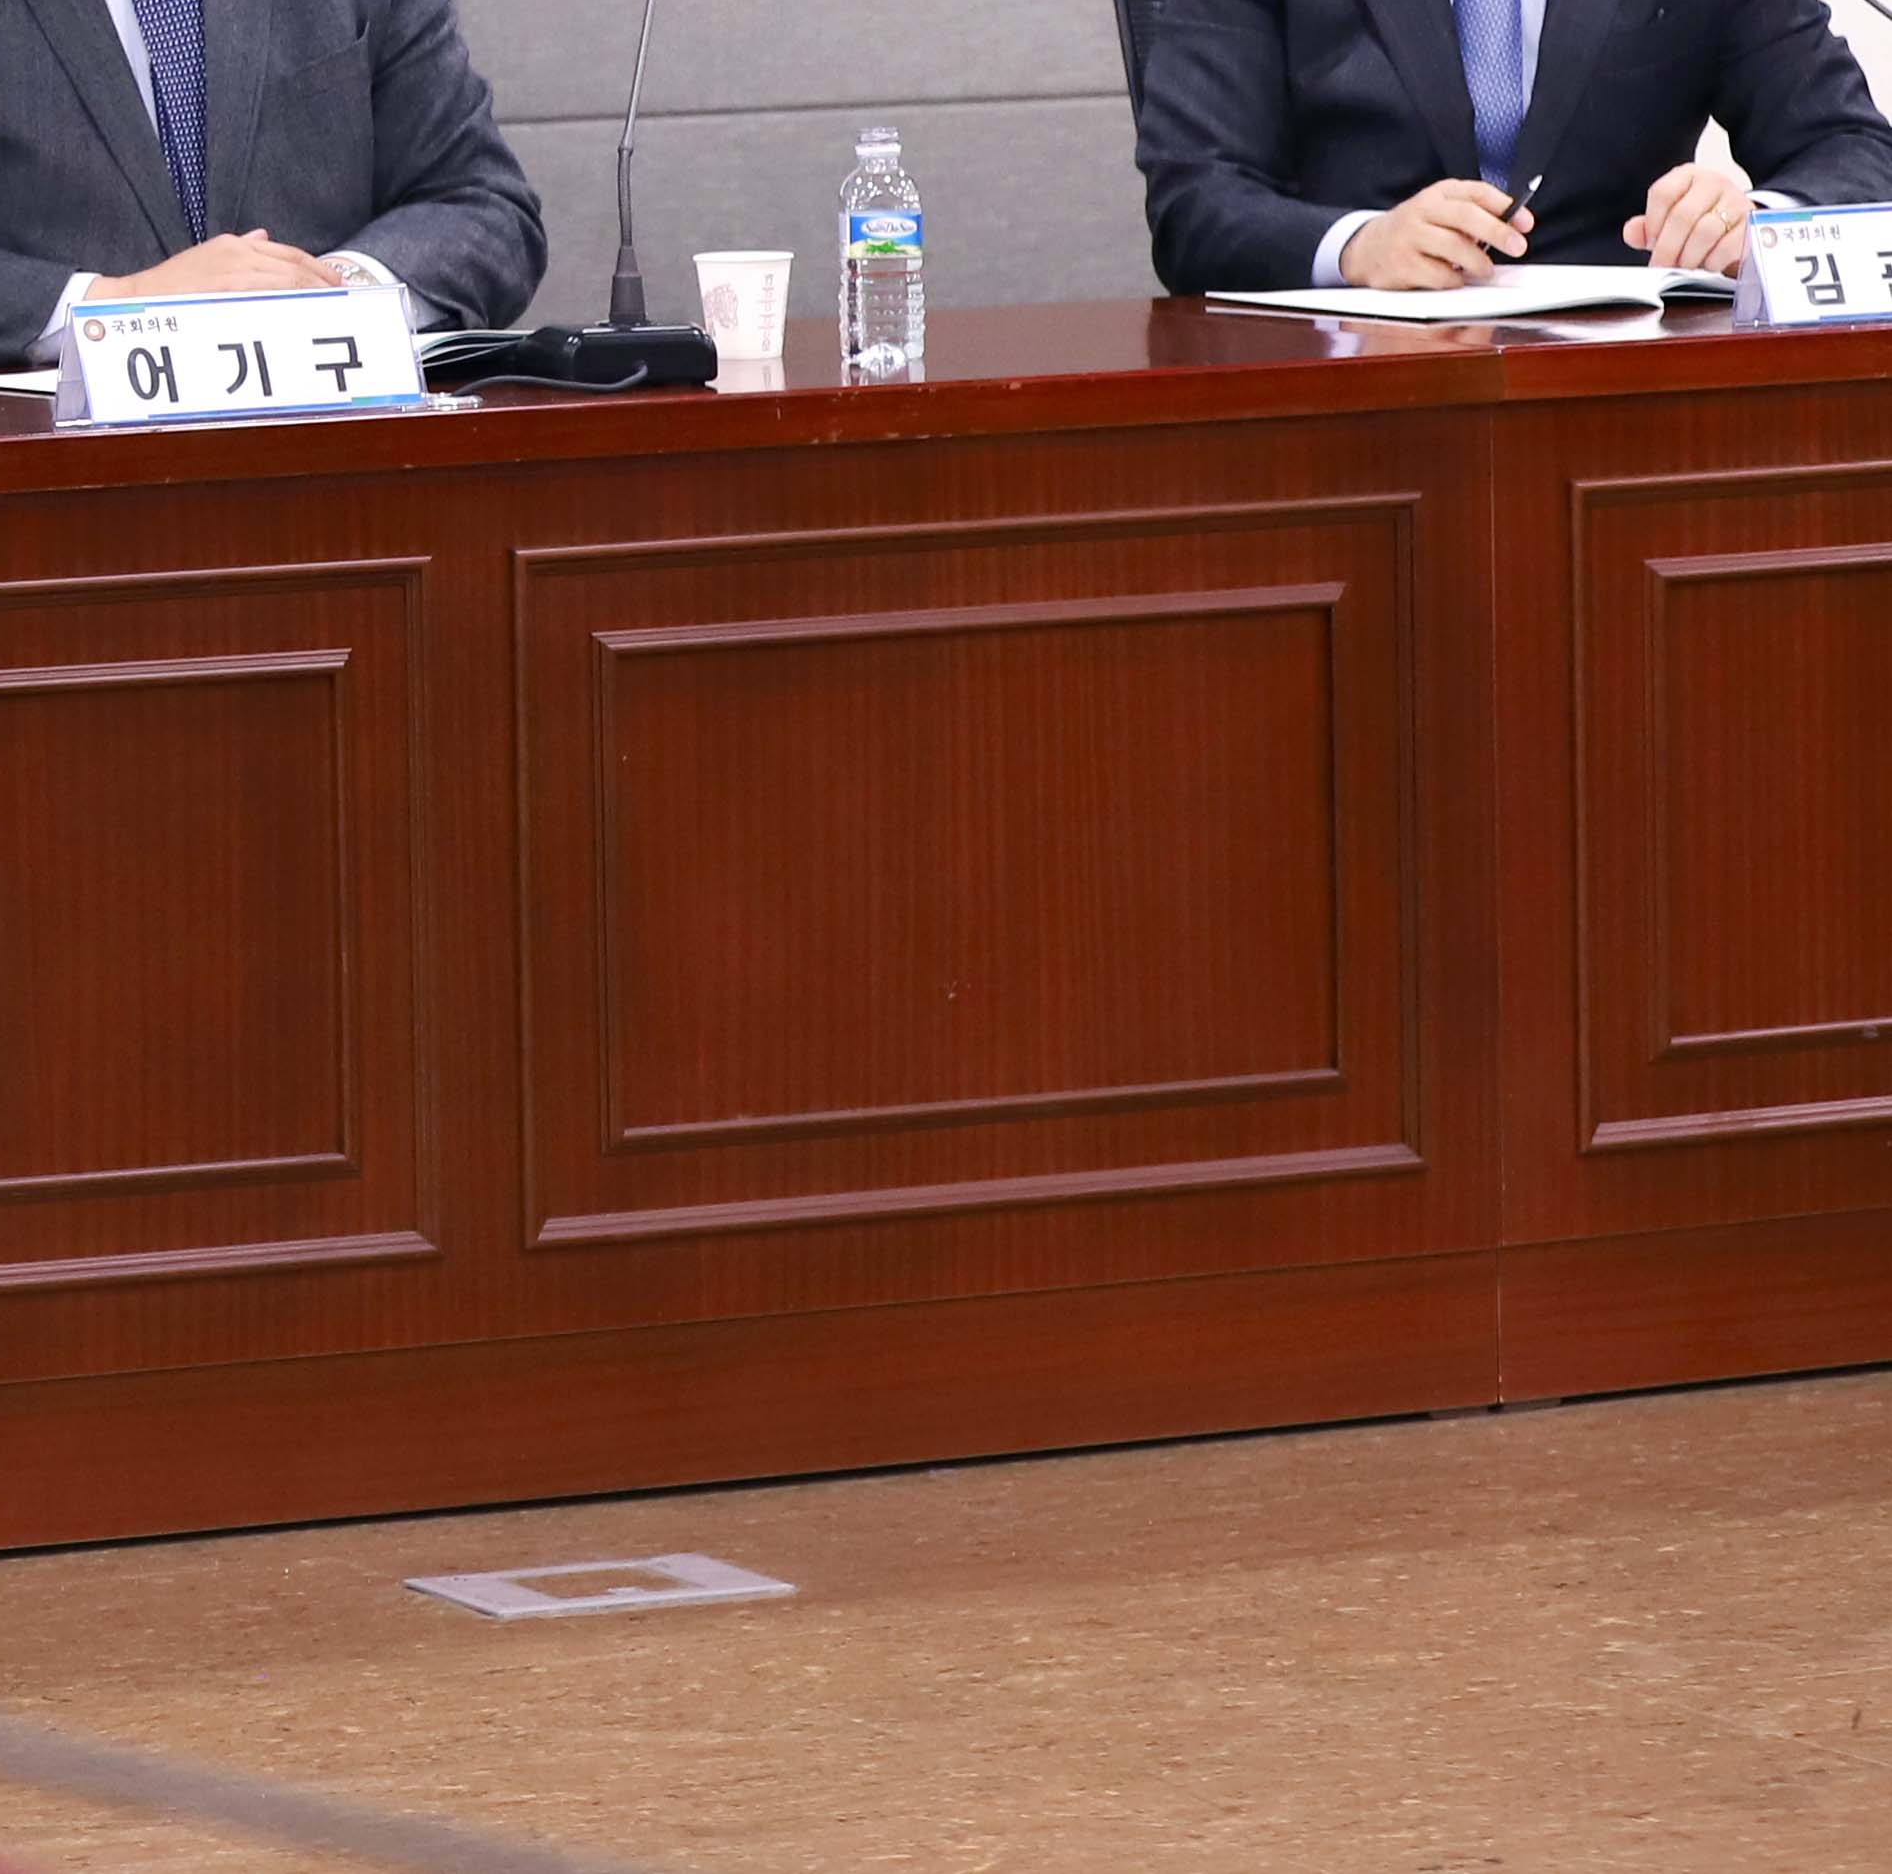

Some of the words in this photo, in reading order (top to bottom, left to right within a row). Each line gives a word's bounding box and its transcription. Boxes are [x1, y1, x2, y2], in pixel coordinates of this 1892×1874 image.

[1783, 225, 1841, 242] 국회의원
[112, 316, 178, 334] 국회의원
[127, 336, 362, 403] 어기구
